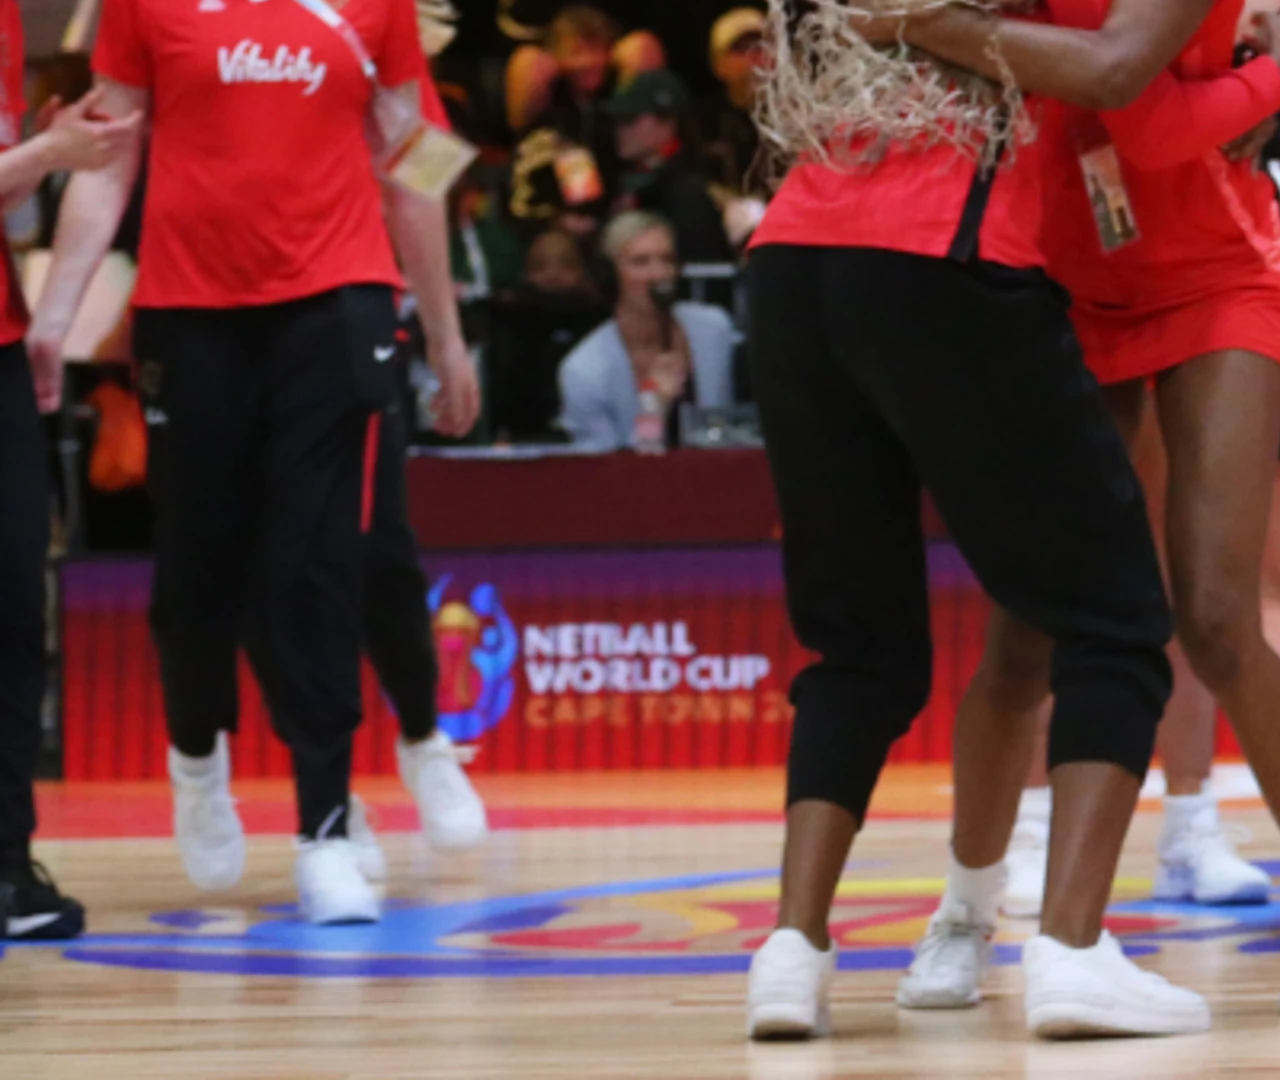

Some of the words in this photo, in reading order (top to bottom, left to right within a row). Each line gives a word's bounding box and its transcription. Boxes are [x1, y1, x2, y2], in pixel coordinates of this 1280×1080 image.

[217, 38, 327, 96] Vitality
[523, 621, 697, 657] NETBALL
[525, 657, 680, 694] WORLD
[685, 654, 771, 691] CUP
[525, 695, 630, 727] CAPE
